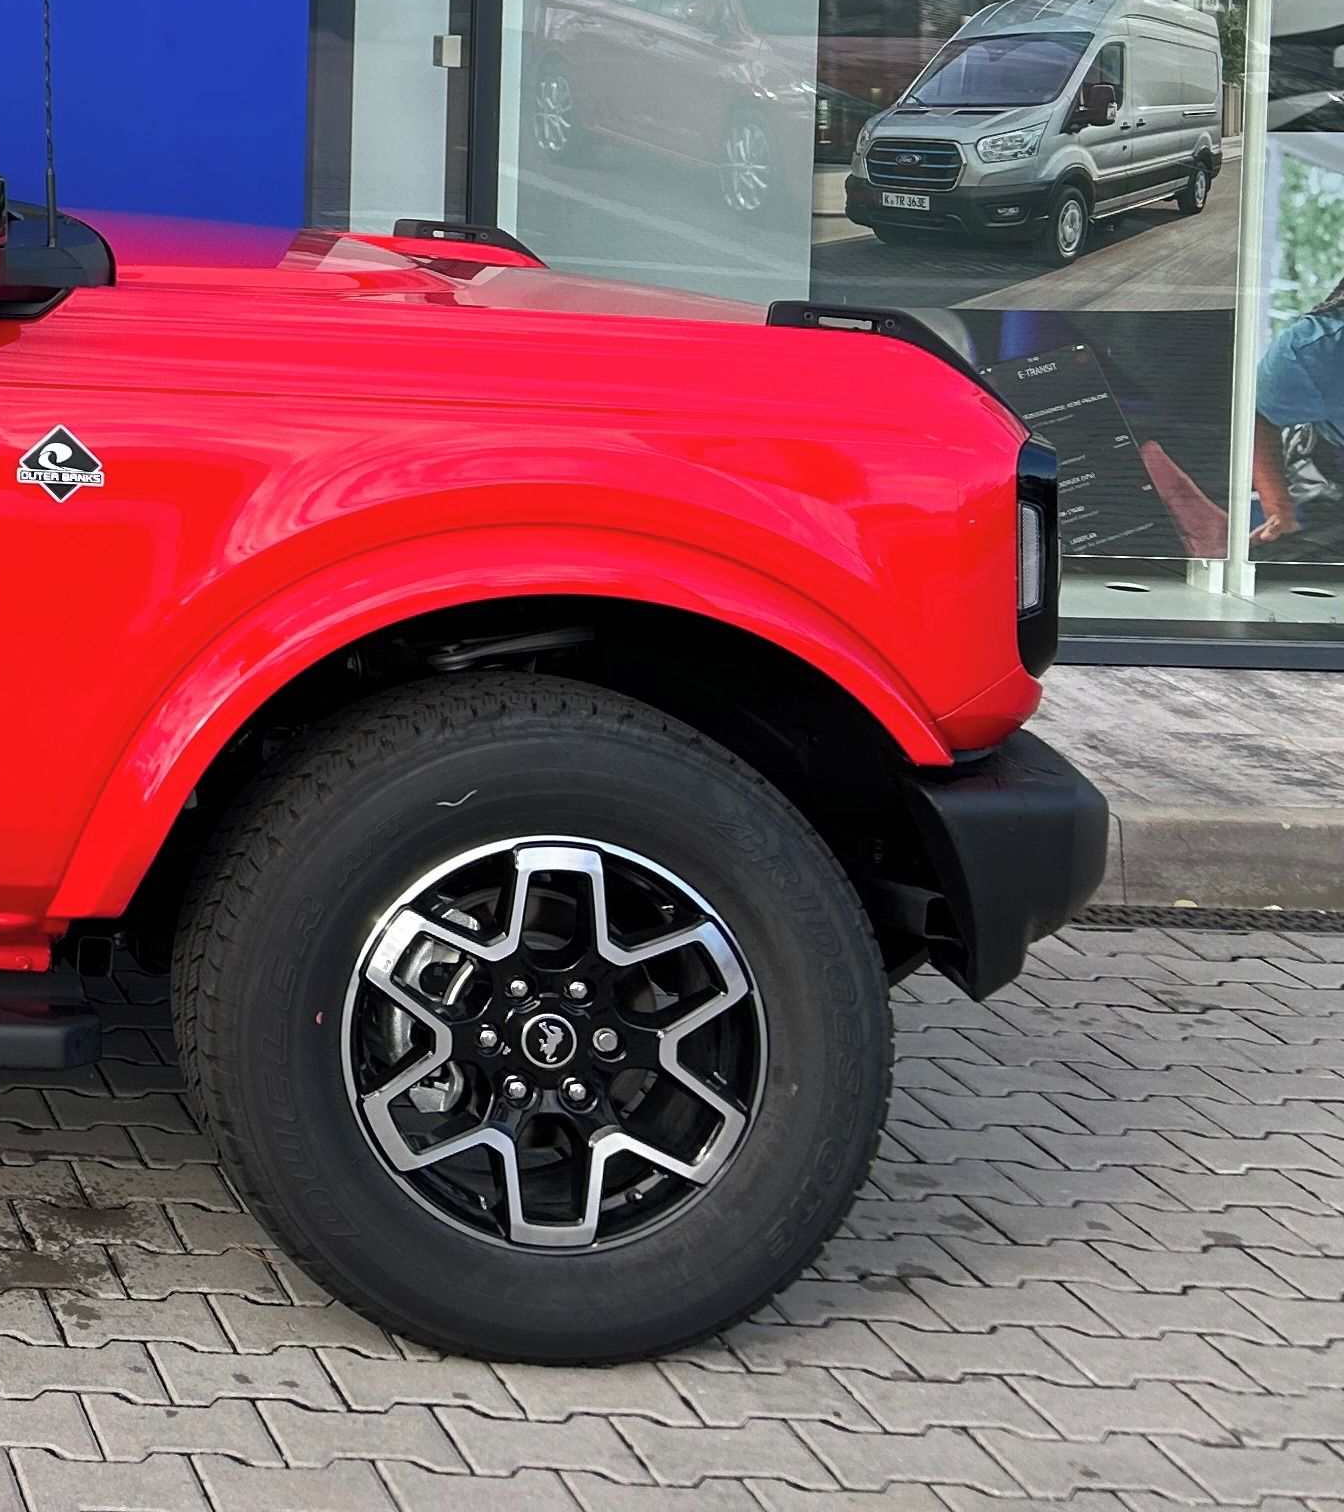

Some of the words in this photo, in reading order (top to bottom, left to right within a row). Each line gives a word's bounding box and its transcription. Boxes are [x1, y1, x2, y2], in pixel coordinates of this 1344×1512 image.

[1017, 362, 1058, 380] E-TRANSIT
[20, 471, 60, 482] OUTER
[61, 473, 102, 484] BANKS
